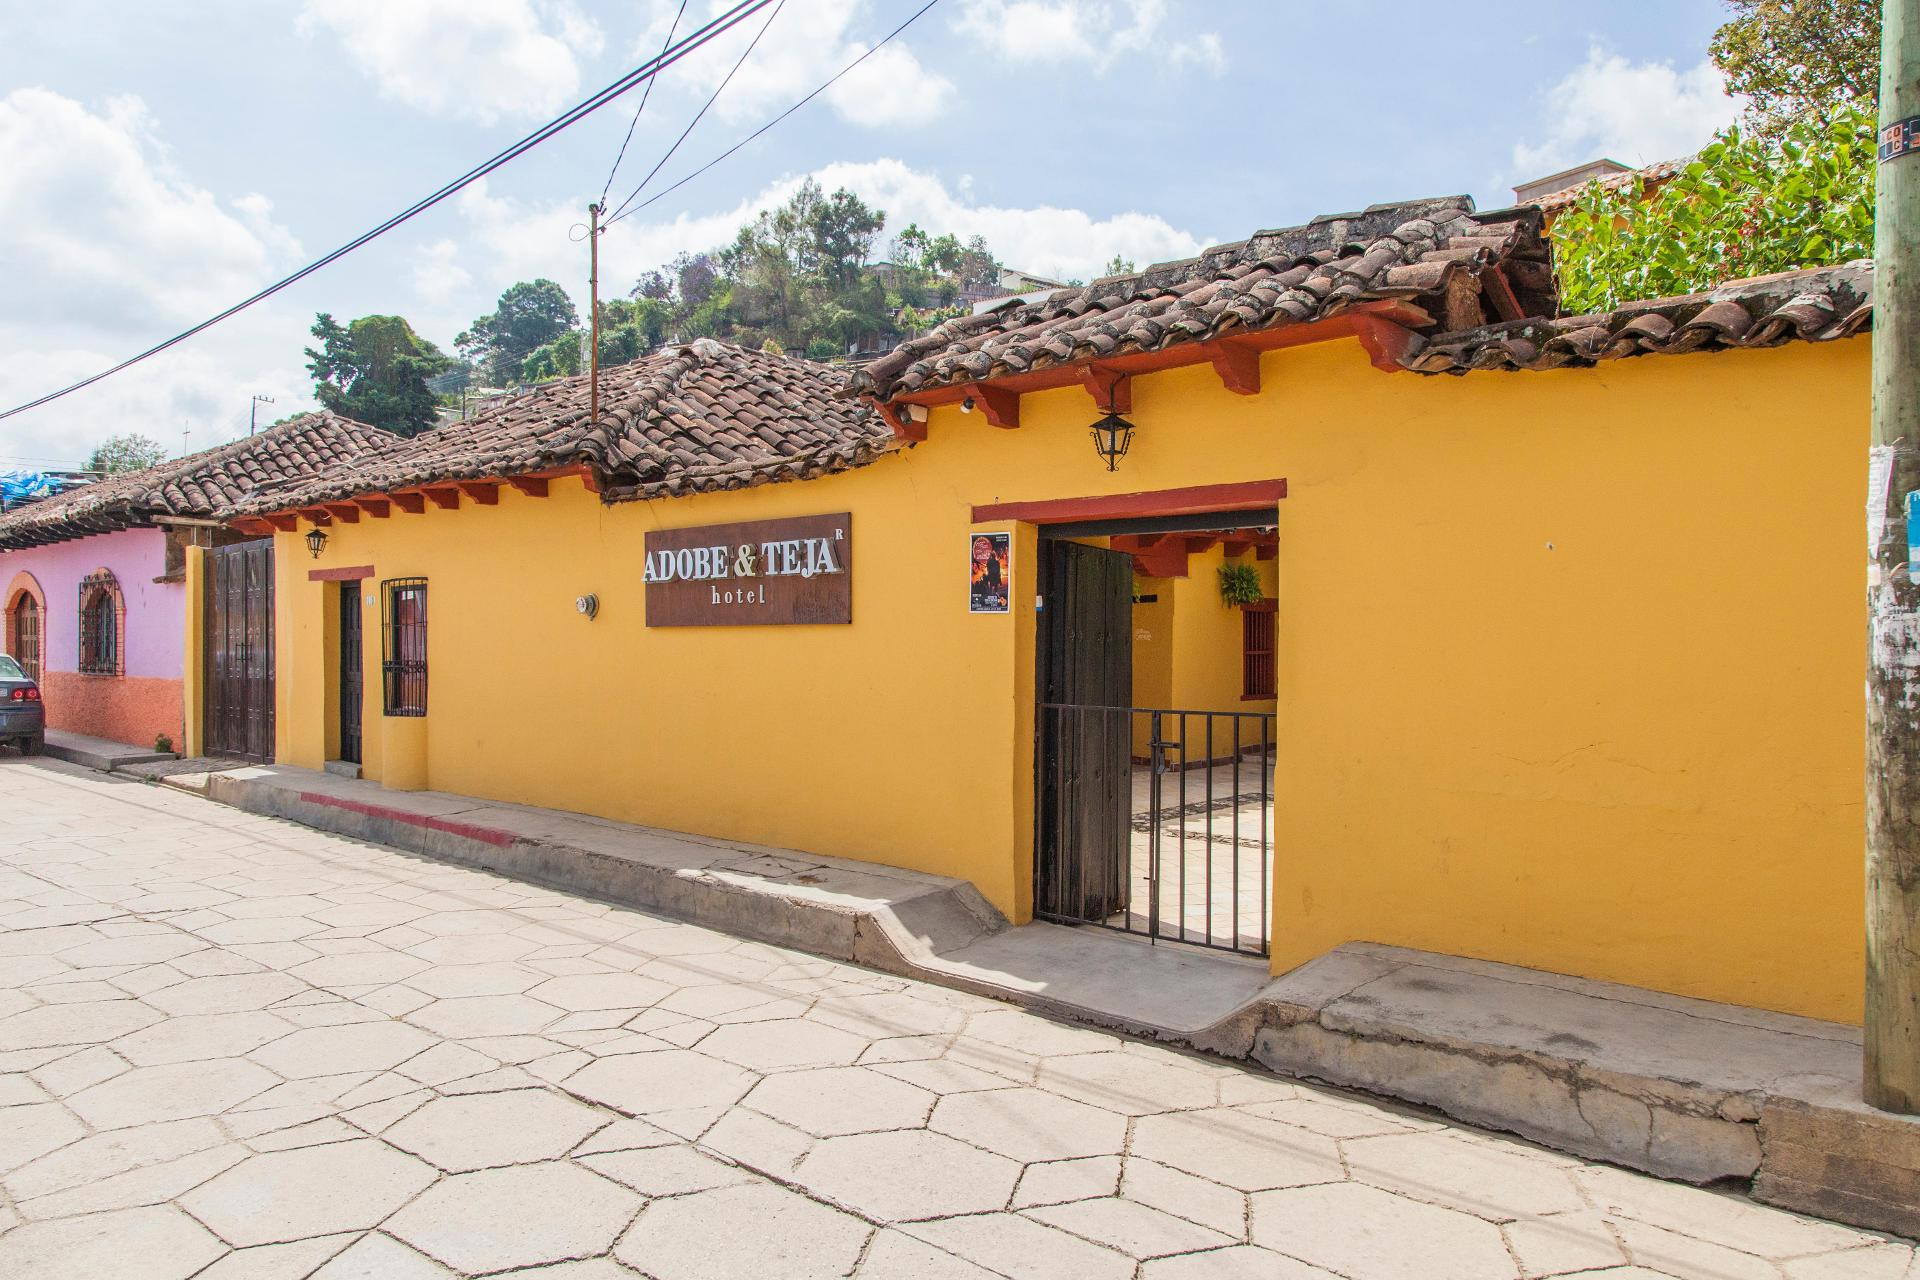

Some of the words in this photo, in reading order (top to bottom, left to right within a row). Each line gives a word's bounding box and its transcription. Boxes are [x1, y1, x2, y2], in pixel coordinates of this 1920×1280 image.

[641, 545, 728, 582] ADOBE
[734, 544, 756, 577] &
[761, 537, 837, 578] TEJA
[711, 584, 765, 605] hotel
